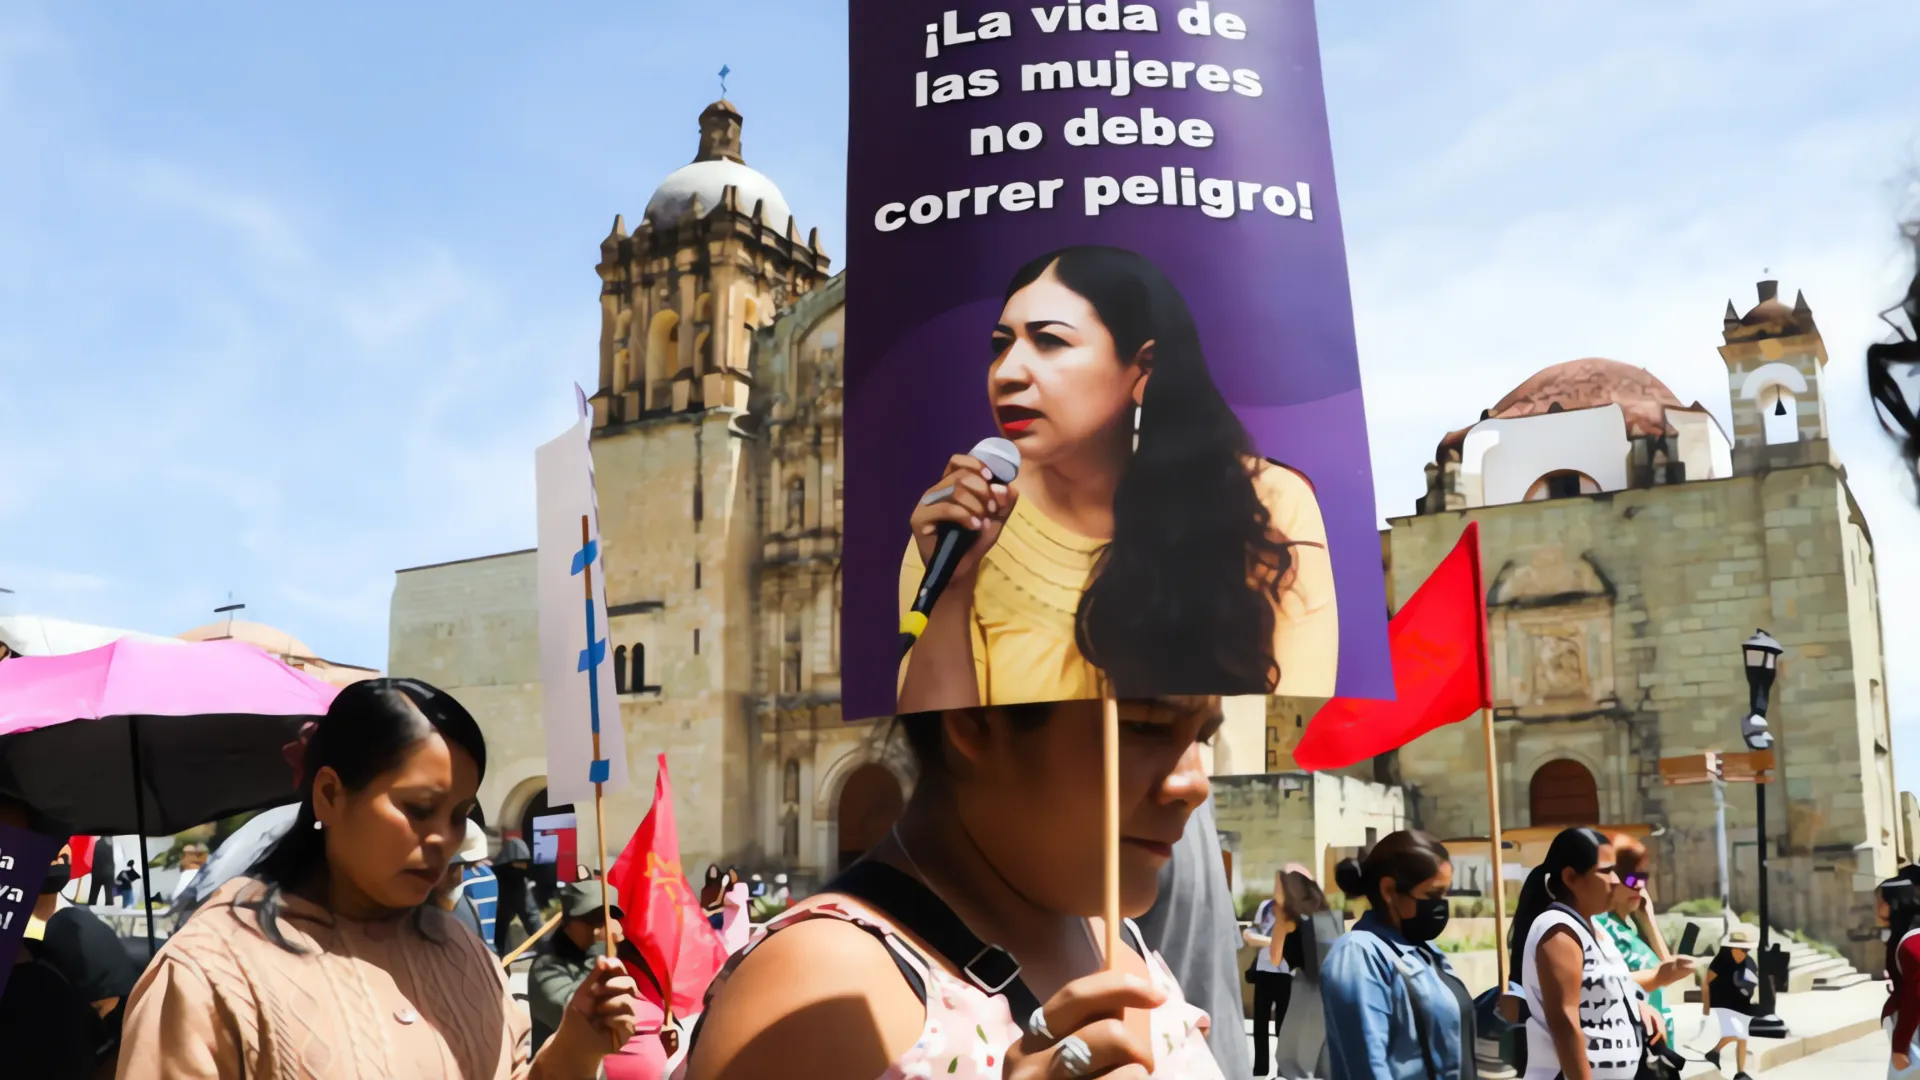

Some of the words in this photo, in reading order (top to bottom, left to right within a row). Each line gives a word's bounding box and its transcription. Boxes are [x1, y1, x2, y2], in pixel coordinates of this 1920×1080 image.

[926, 10, 1012, 58] ¡La
[1031, 0, 1159, 33] vida
[1176, 0, 1249, 41] de
[915, 68, 1001, 108] las
[1020, 50, 1264, 98] mujeres
[970, 120, 1044, 156] no
[1063, 107, 1216, 148] debe
[873, 178, 1065, 233] correr
[1084, 166, 1315, 221] peligro!
[0, 847, 15, 871] a
